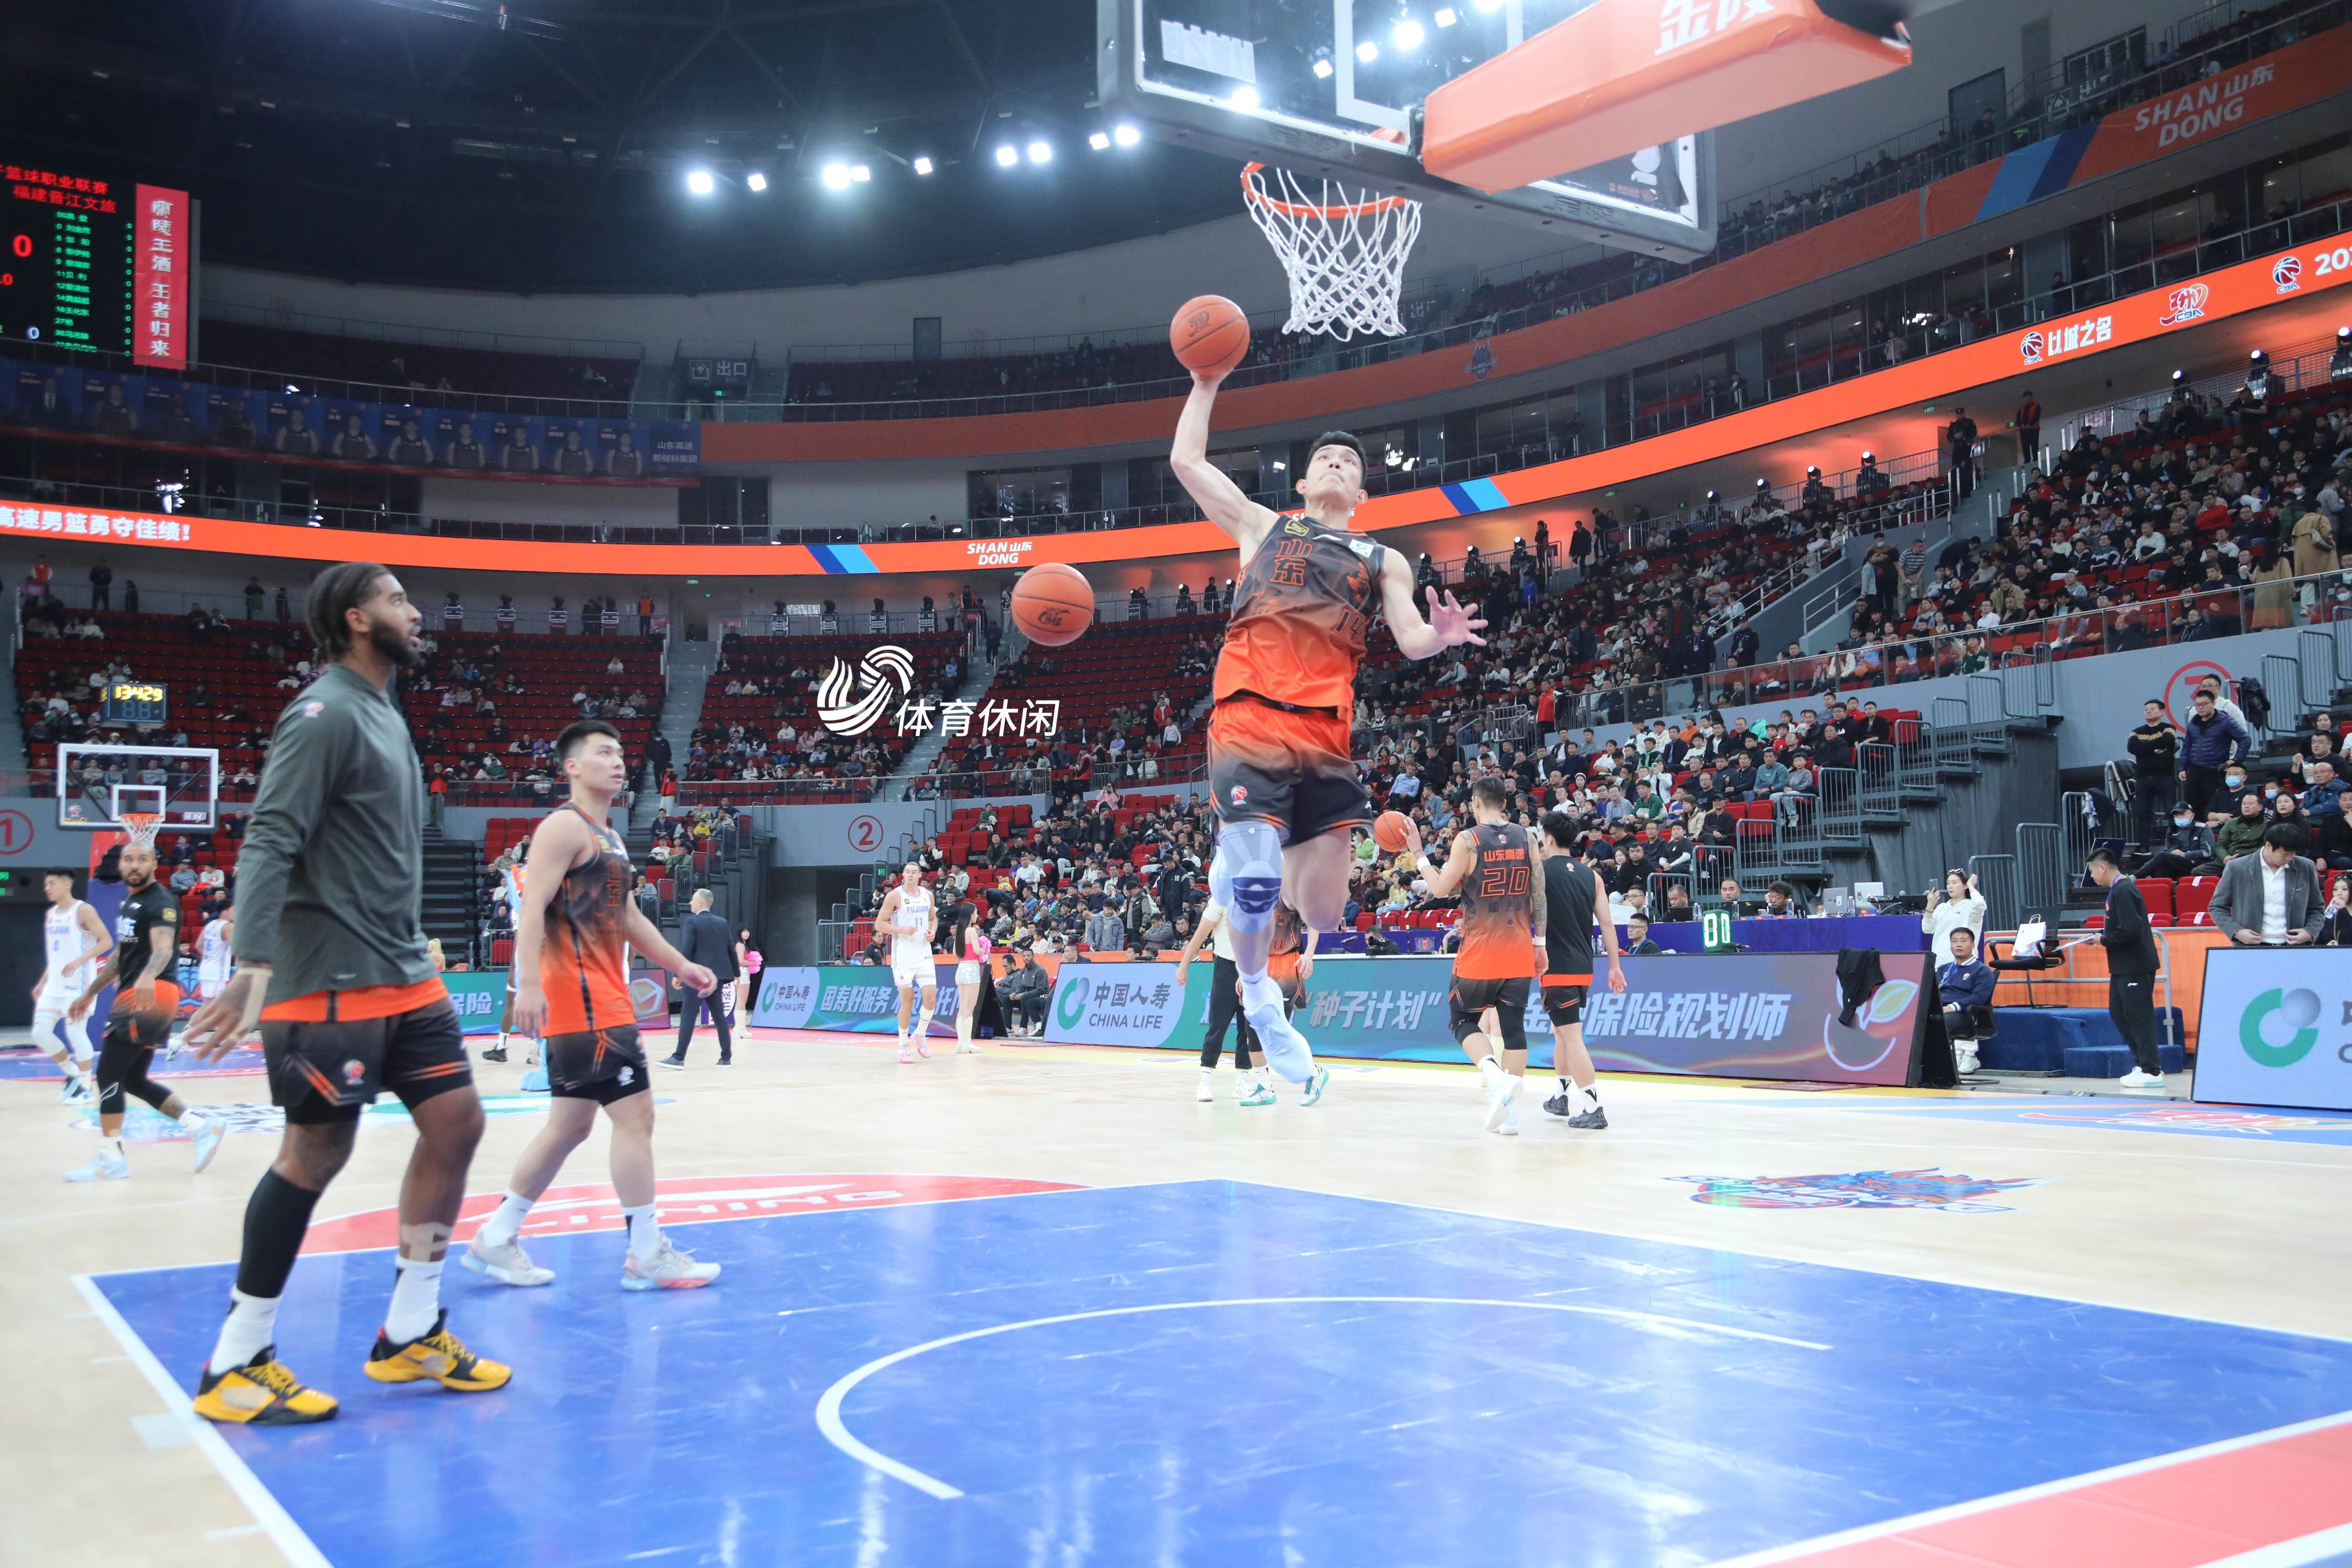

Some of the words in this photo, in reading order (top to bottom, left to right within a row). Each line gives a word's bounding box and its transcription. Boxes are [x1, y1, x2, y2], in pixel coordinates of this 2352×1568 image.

[1653, 0, 1775, 55] 金
[2135, 82, 2218, 131] SHAN
[2224, 63, 2274, 99] 山东
[2159, 96, 2243, 147] DONG
[0, 164, 109, 194] 篮球职业联赛
[13, 185, 116, 213] 福建晋江文旅
[13, 235, 33, 257] 0
[2314, 248, 2352, 276] 20
[2277, 283, 2300, 294] CBA
[150, 283, 171, 357] 王者归来
[2175, 308, 2204, 322] CBA
[27, 327, 40, 340] 0
[2047, 316, 2112, 357] 以城之名
[717, 361, 747, 376] 出口
[2024, 356, 2042, 365] CBA
[653, 454, 697, 463] 新材料集团
[658, 442, 693, 450] 山东高速
[0, 506, 190, 541] 高速男篮勇夺佳绩！
[967, 542, 1008, 554] SHAN
[1010, 542, 1032, 552] 山东
[978, 553, 1018, 565] DONG
[1269, 538, 1312, 586] 山东
[1331, 608, 1366, 641] 14
[0, 818, 13, 847] 1
[858, 821, 874, 846] 2
[1484, 849, 1524, 861] 山东高速
[1478, 867, 1530, 897] 20
[915, 917, 922, 926] 11
[778, 985, 810, 999] 中国人寿
[820, 986, 892, 1014] 国寿好服务
[1094, 981, 1170, 1009] 中国人寿
[1089, 1014, 1128, 1027] CHINA
[1133, 1015, 1163, 1028] LIFE
[1523, 992, 1791, 1041] 金保险规划师
